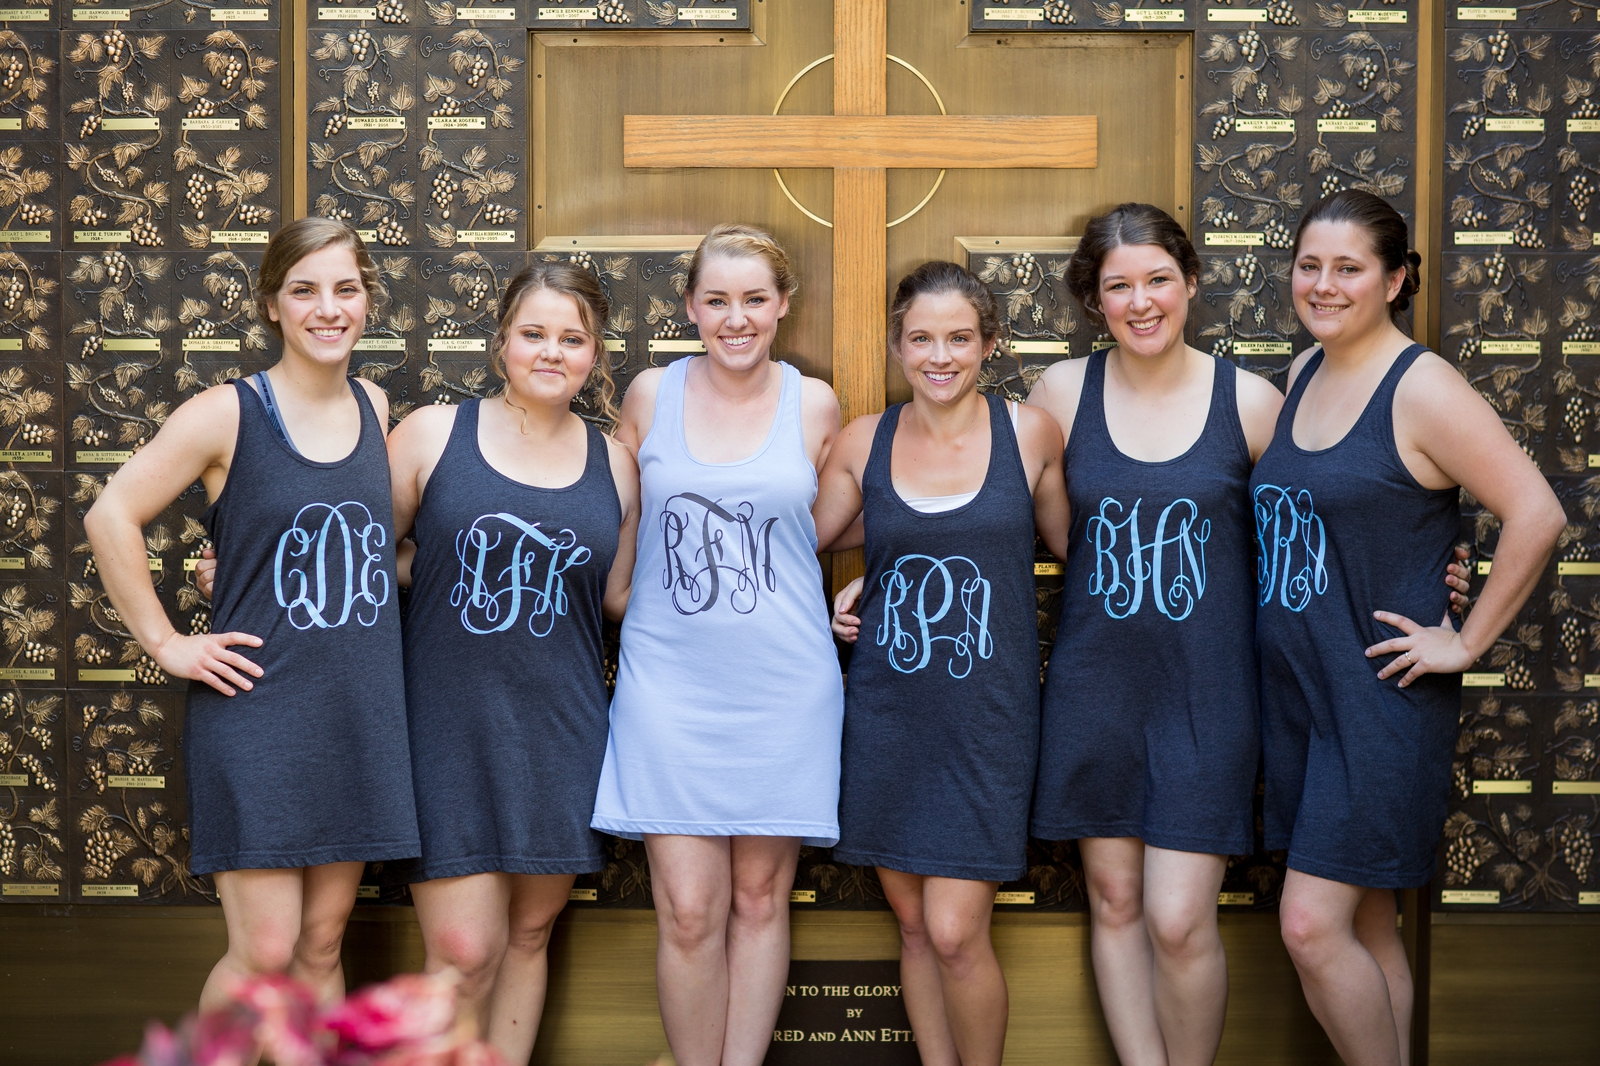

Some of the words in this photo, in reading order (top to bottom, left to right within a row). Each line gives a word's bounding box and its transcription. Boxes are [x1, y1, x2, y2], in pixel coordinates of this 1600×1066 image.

[800, 986, 819, 997] TO
[822, 986, 850, 997] THE
[854, 986, 902, 997] GLORY
[846, 1008, 864, 1018] BY
[808, 1032, 836, 1042] AND
[840, 1028, 876, 1042] ANN
